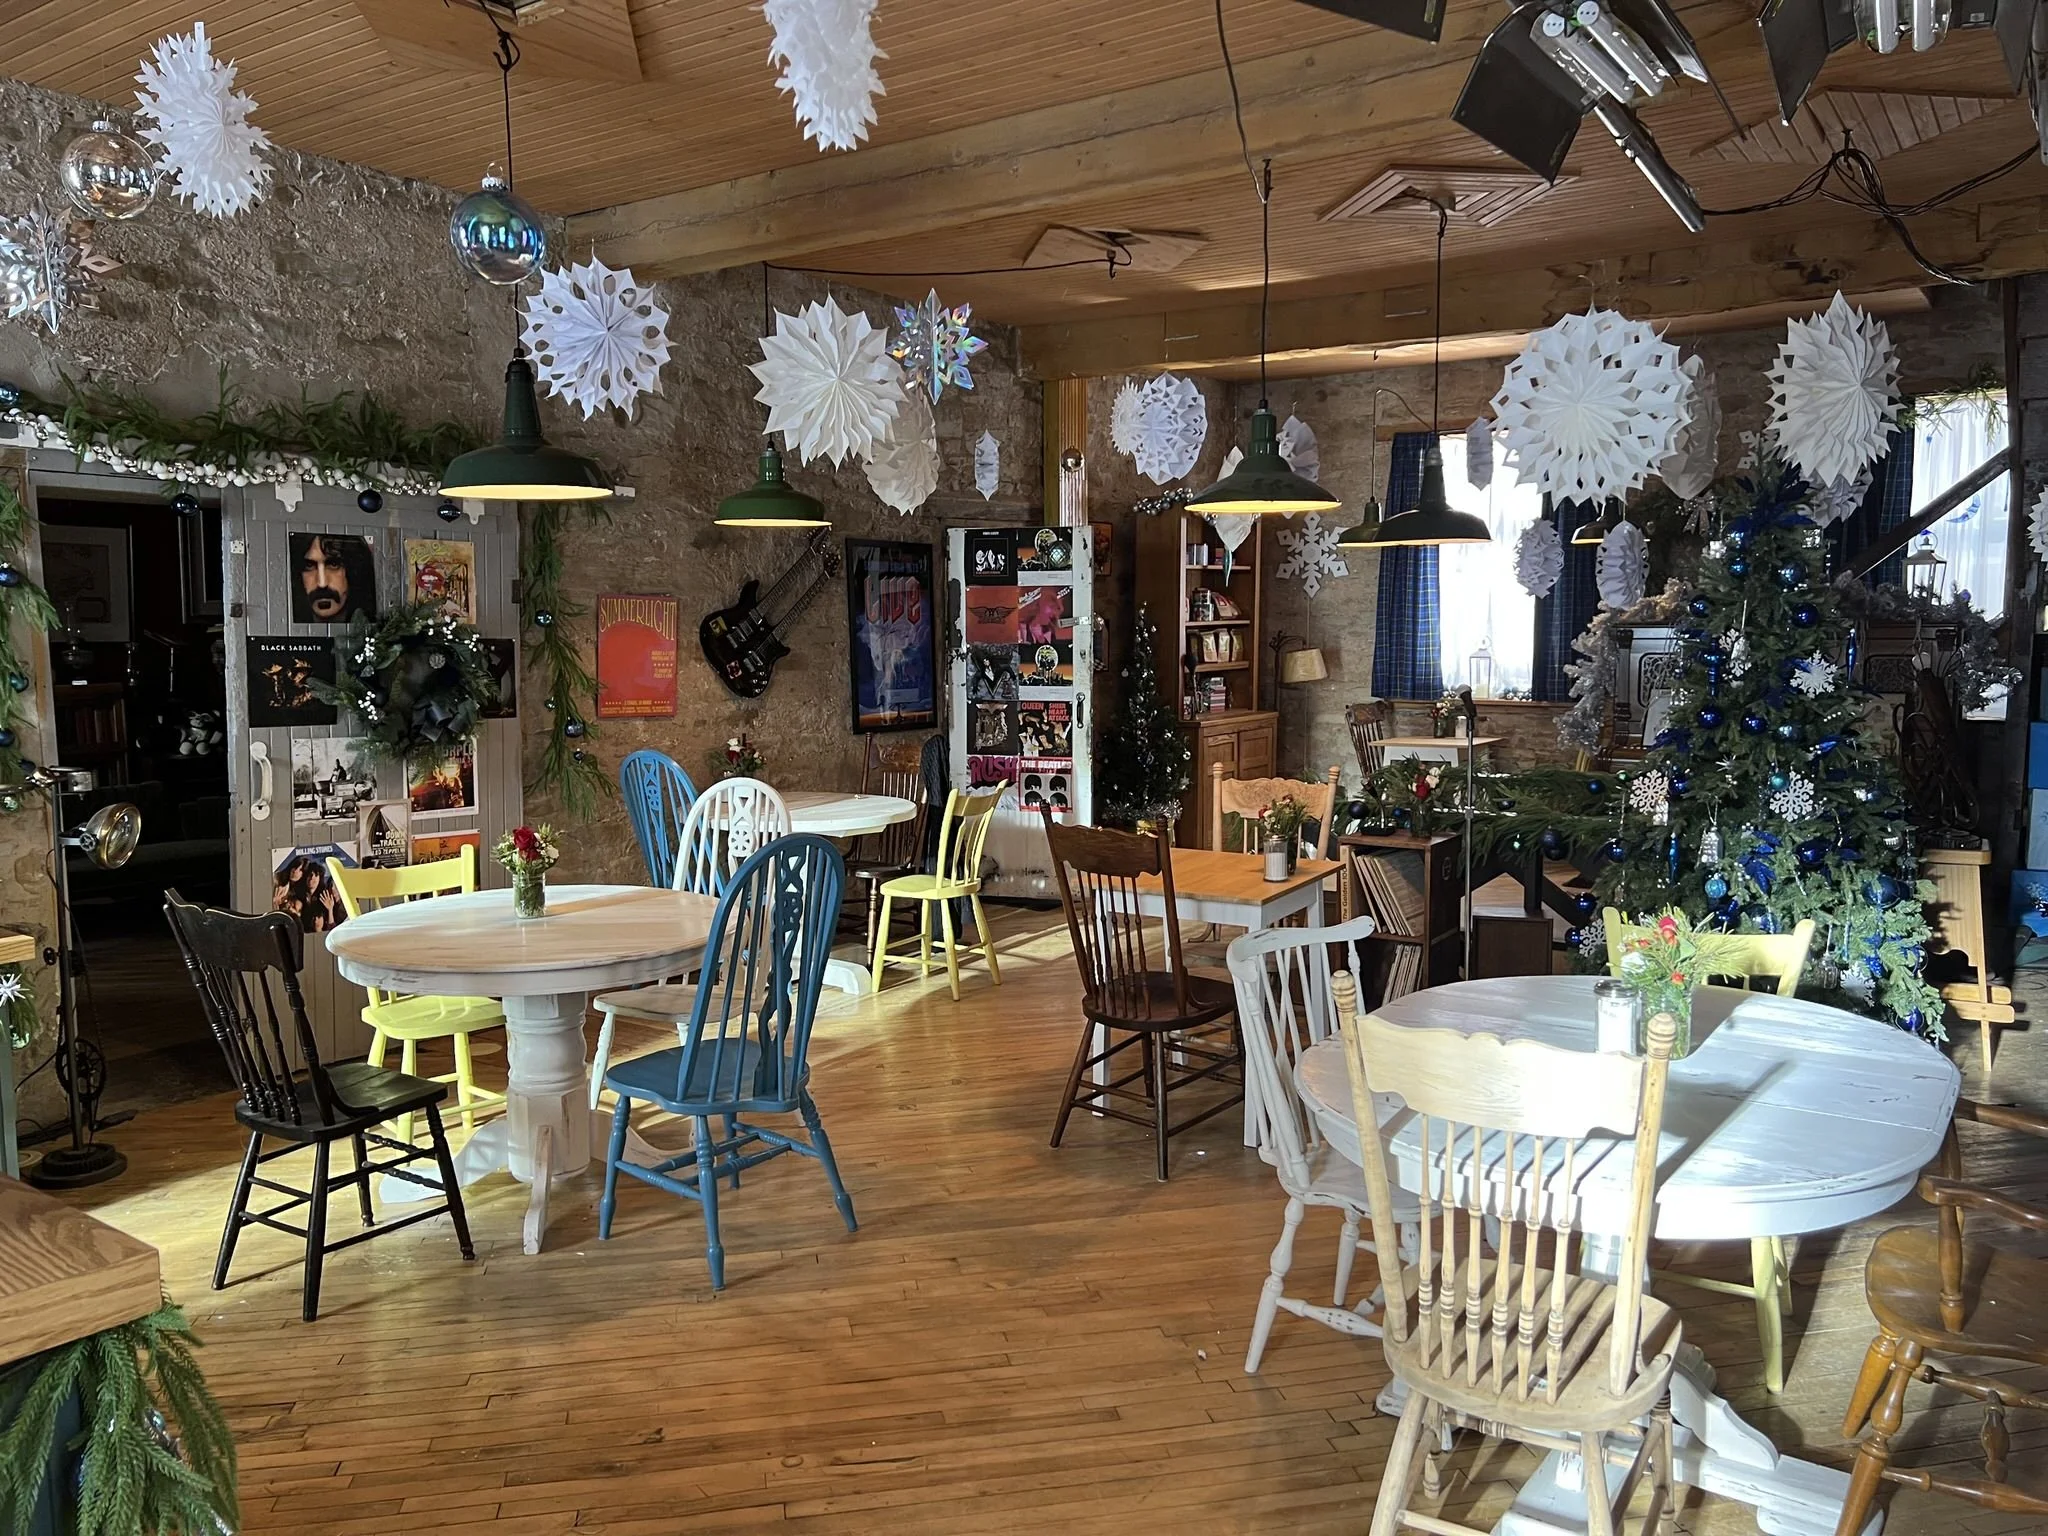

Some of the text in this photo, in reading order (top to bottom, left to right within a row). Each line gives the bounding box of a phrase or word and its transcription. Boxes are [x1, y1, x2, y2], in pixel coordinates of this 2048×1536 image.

[599, 598, 677, 641] SUMMERLIGHT
[260, 644, 322, 652] BLACK SABBATH
[1021, 702, 1044, 711] QUEEN
[967, 755, 1018, 784] RUSH
[1020, 760, 1072, 770] THE BEATLES
